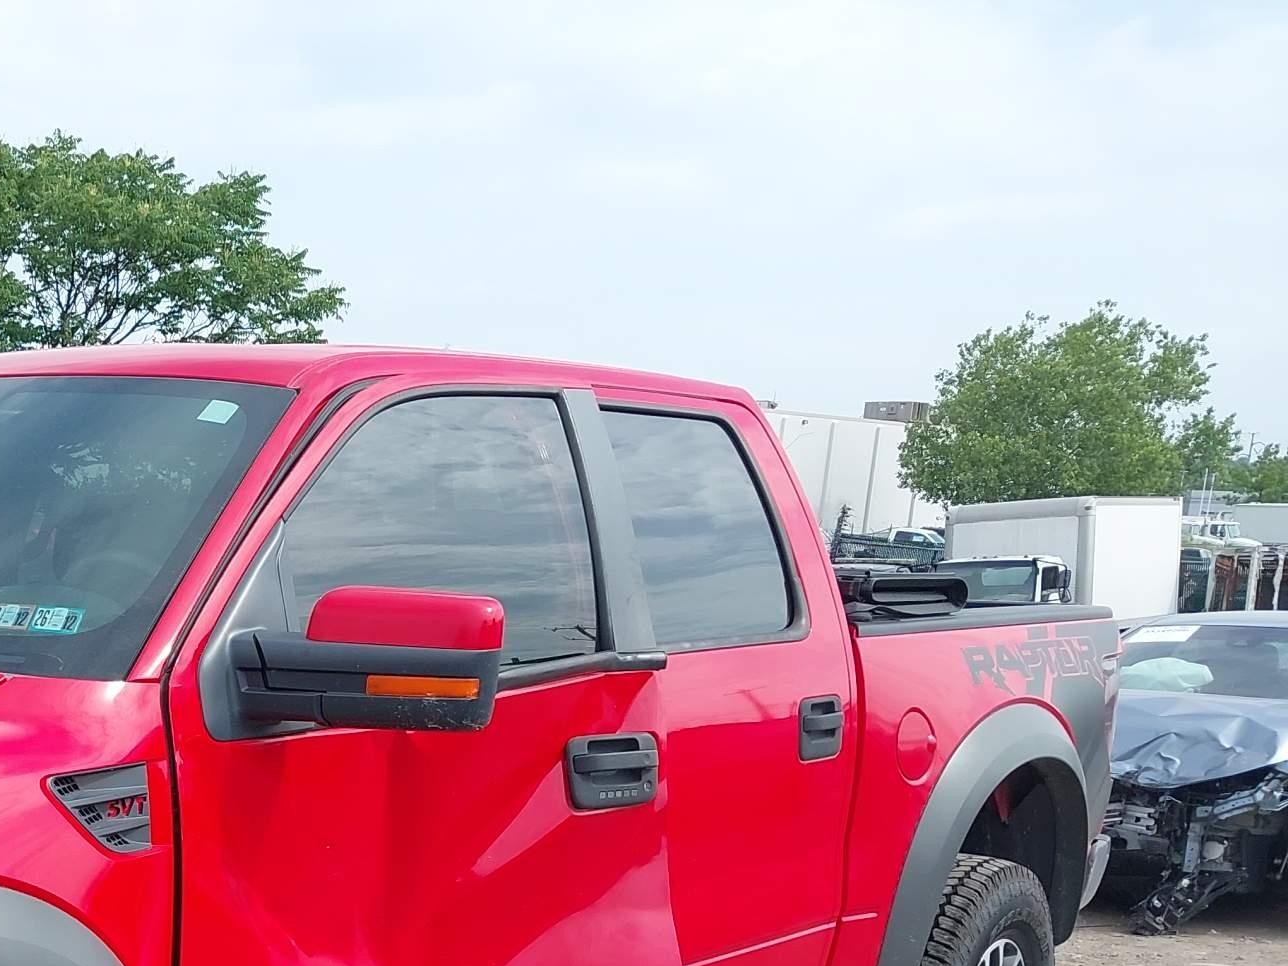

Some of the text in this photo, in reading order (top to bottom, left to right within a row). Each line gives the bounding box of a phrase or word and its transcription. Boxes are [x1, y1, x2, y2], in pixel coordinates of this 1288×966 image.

[13, 610, 30, 628] 12
[33, 608, 78, 632] 26 12
[962, 635, 1105, 697] RAPTOR
[106, 796, 148, 819] SVT
